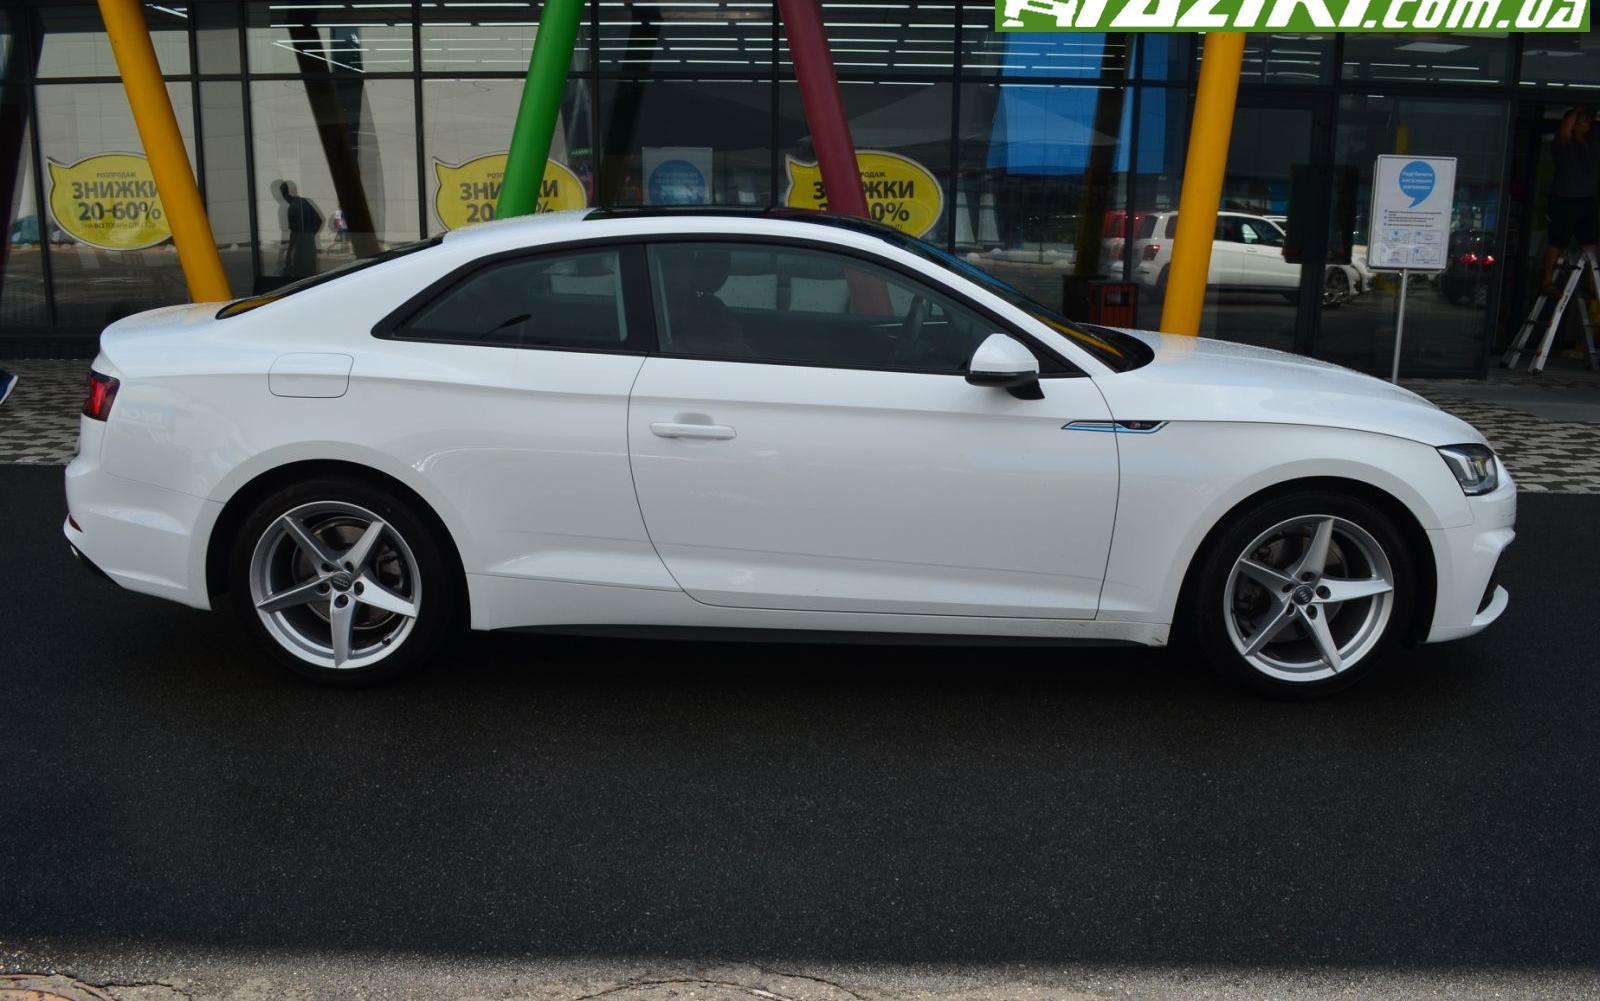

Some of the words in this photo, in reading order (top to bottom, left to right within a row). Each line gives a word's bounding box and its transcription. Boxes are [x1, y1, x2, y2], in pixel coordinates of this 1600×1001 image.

[72, 181, 158, 199] ЗНИЖКИ
[459, 180, 559, 200] ЗНИИ
[813, 181, 915, 200] ЗЖКИ
[78, 201, 162, 221] 20-60%
